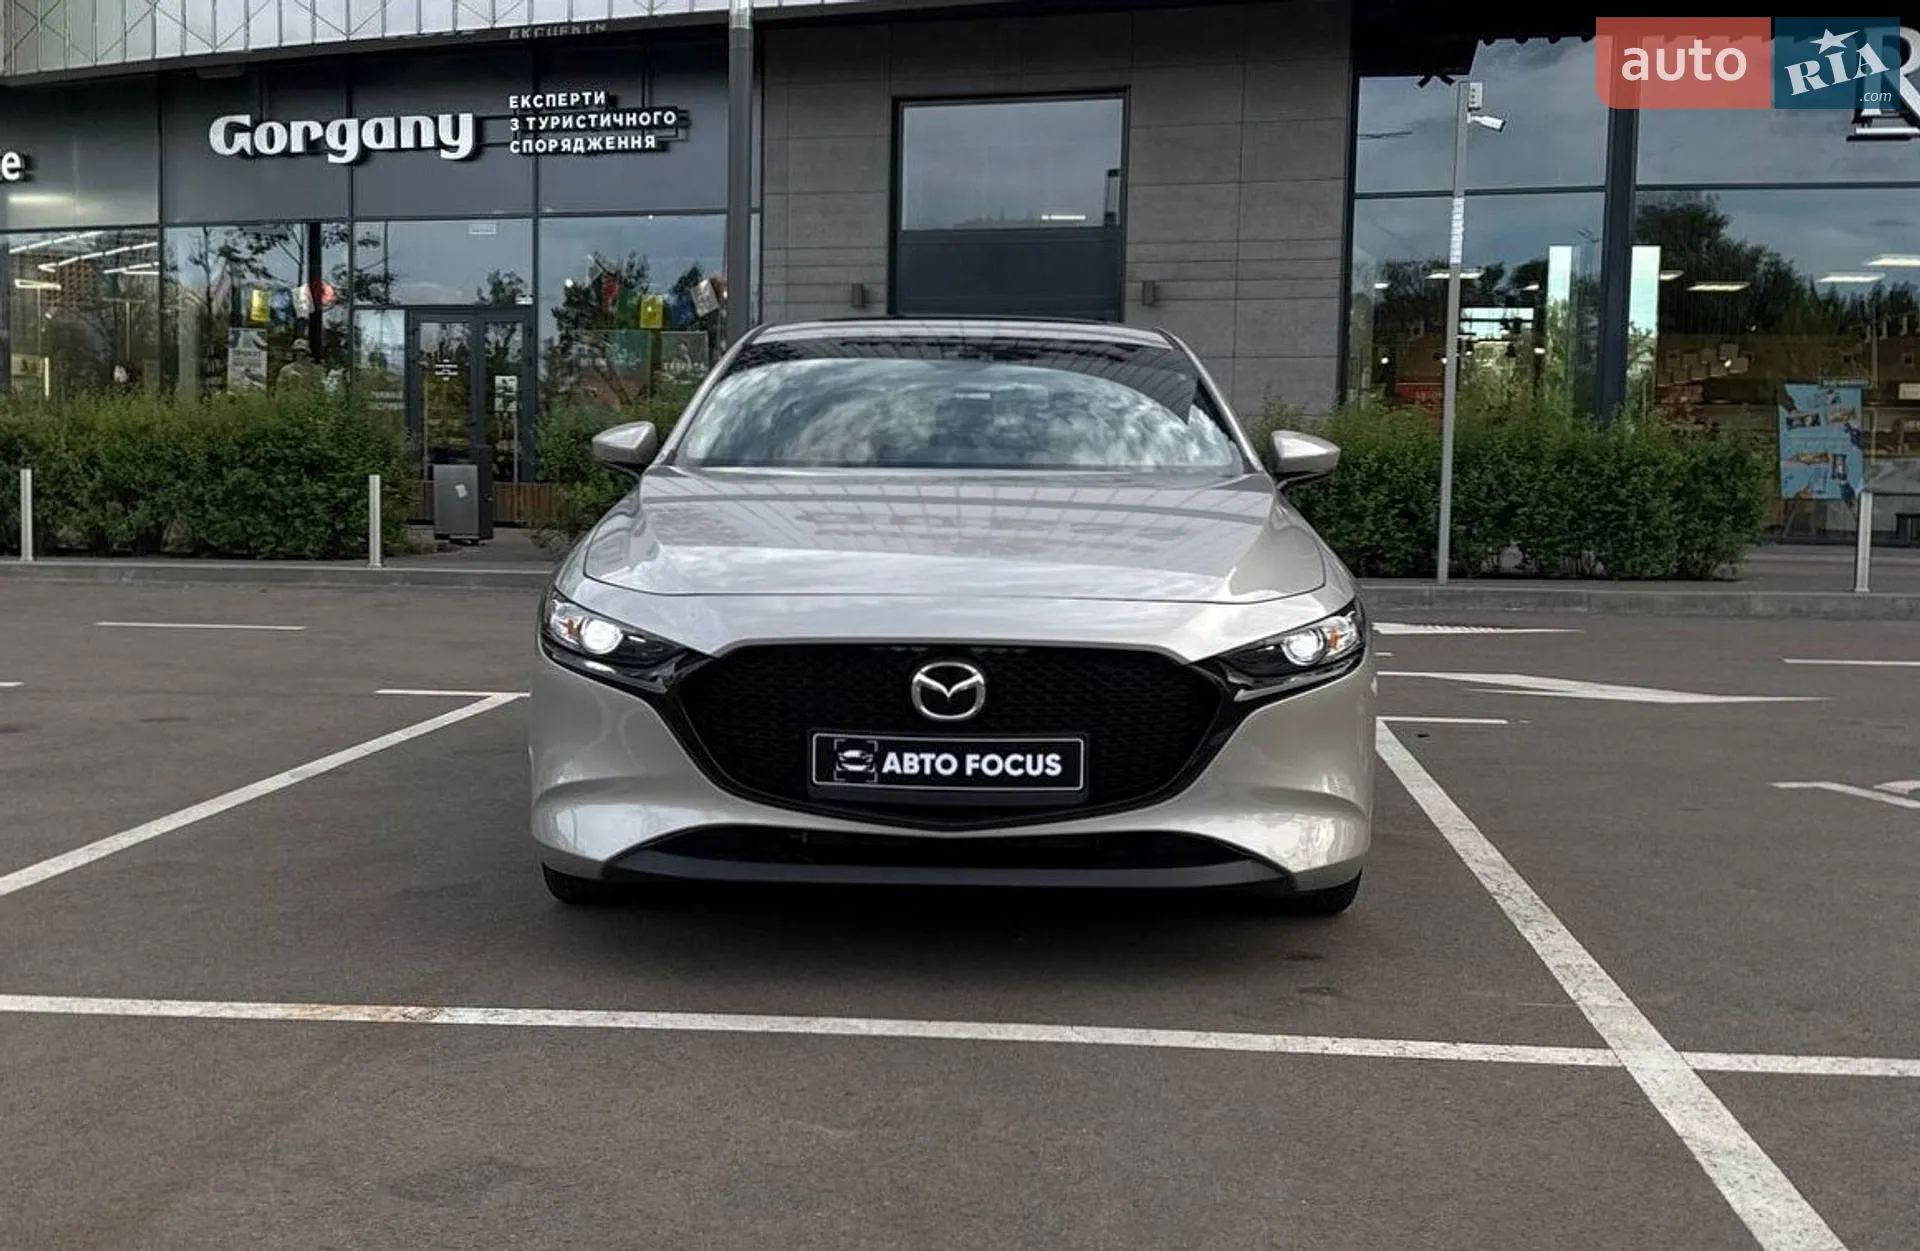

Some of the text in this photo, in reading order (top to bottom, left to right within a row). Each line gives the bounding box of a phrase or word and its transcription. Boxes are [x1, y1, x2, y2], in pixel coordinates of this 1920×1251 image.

[509, 91, 606, 109] ЕКСПЕРТИ
[526, 110, 677, 131] ТУРИСТИЧНОГО
[208, 112, 474, 164] Gorgany
[509, 135, 656, 154] СПОРЯДЖЕННЯ
[965, 753, 1063, 777] FOCUS
